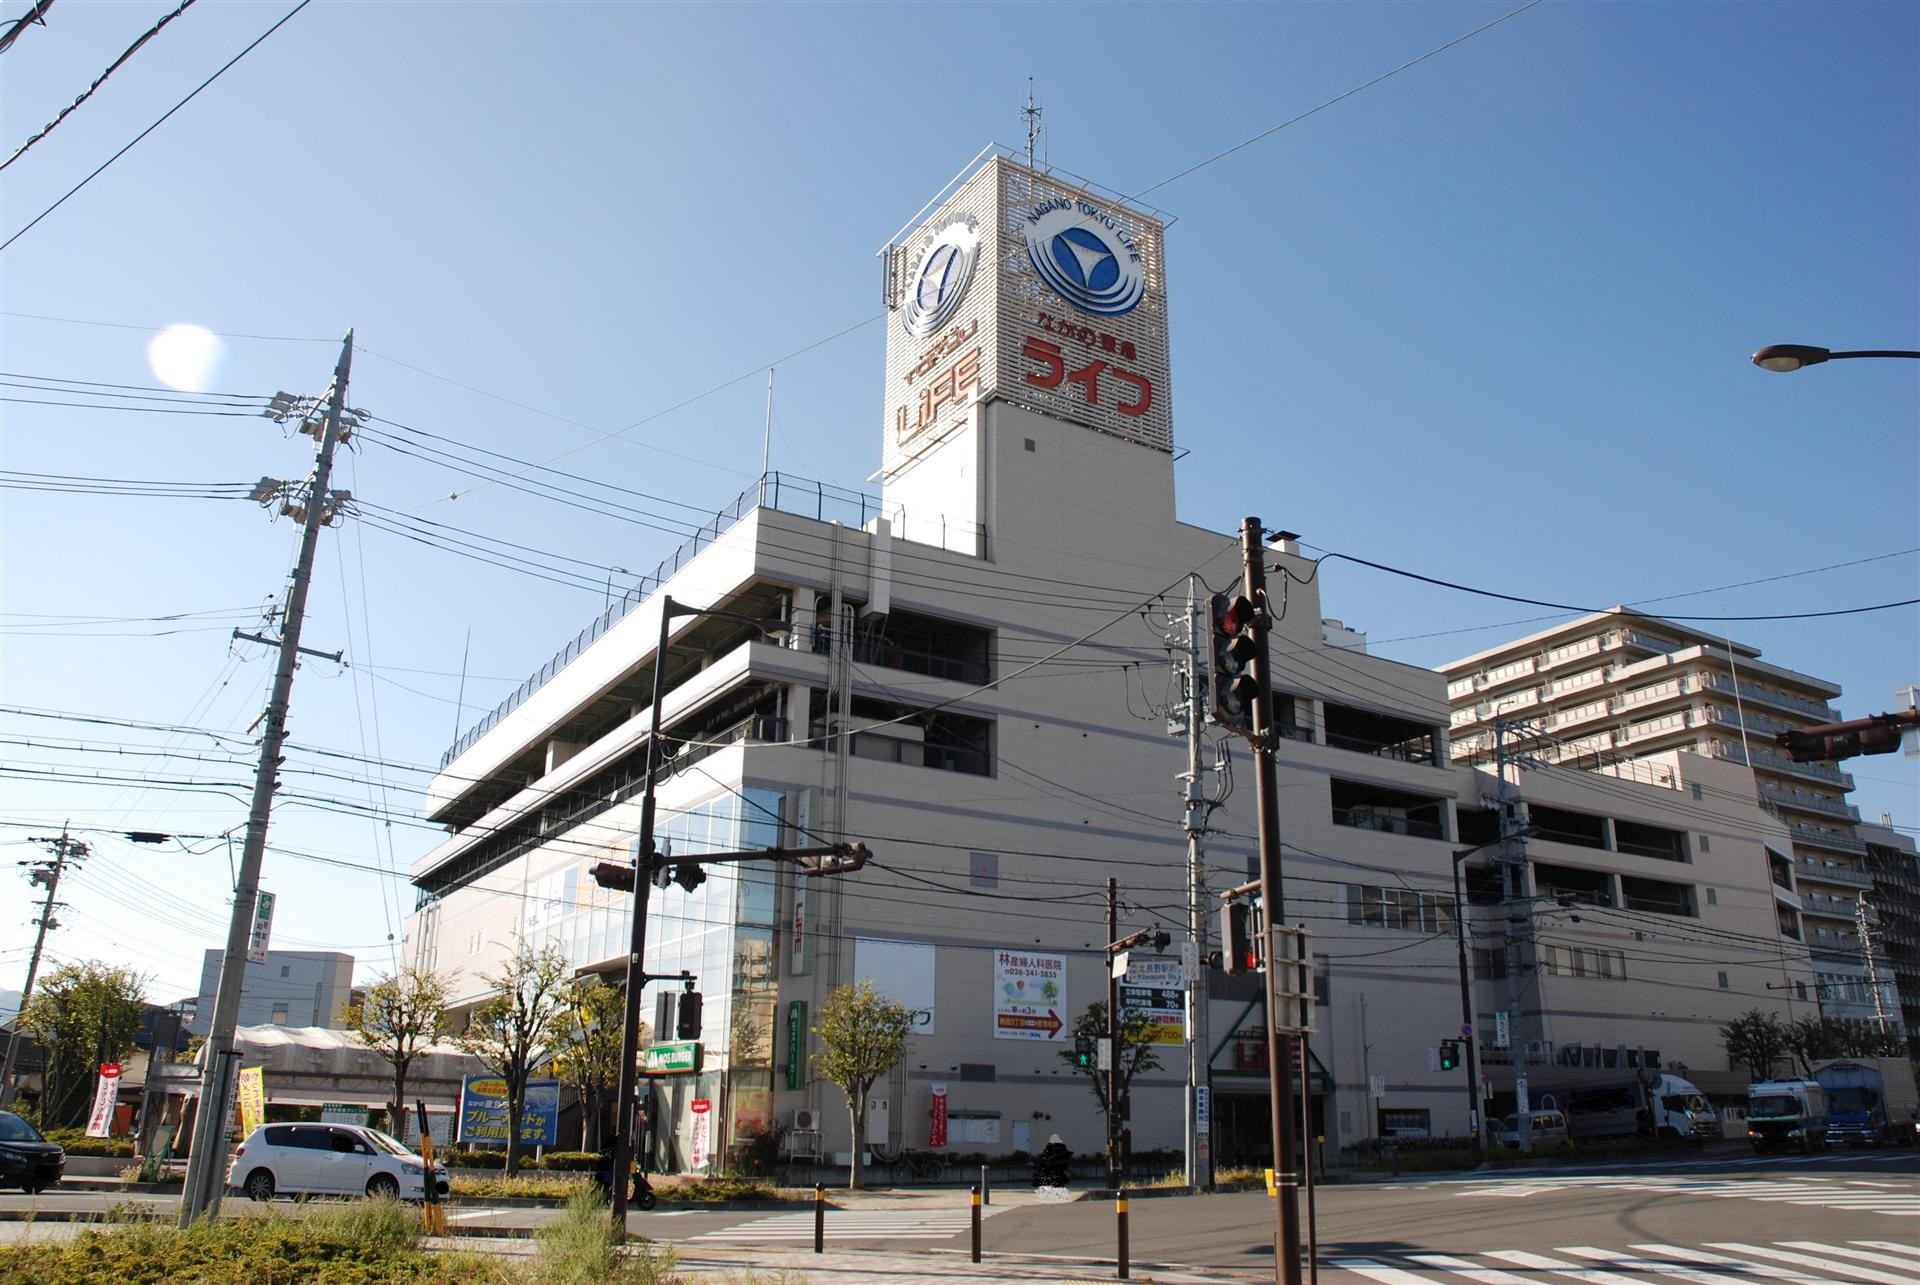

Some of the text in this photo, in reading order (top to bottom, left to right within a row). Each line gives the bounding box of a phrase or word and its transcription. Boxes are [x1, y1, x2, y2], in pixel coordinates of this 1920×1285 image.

[1027, 198, 1142, 264] NAGANO TOKYU LIFE
[1023, 336, 1152, 417] ライフ
[999, 951, 1062, 970] 林産婦人科医院
[466, 1110, 546, 1126] ブルーカドが
[464, 1125, 547, 1141] ご利用頂ます。
